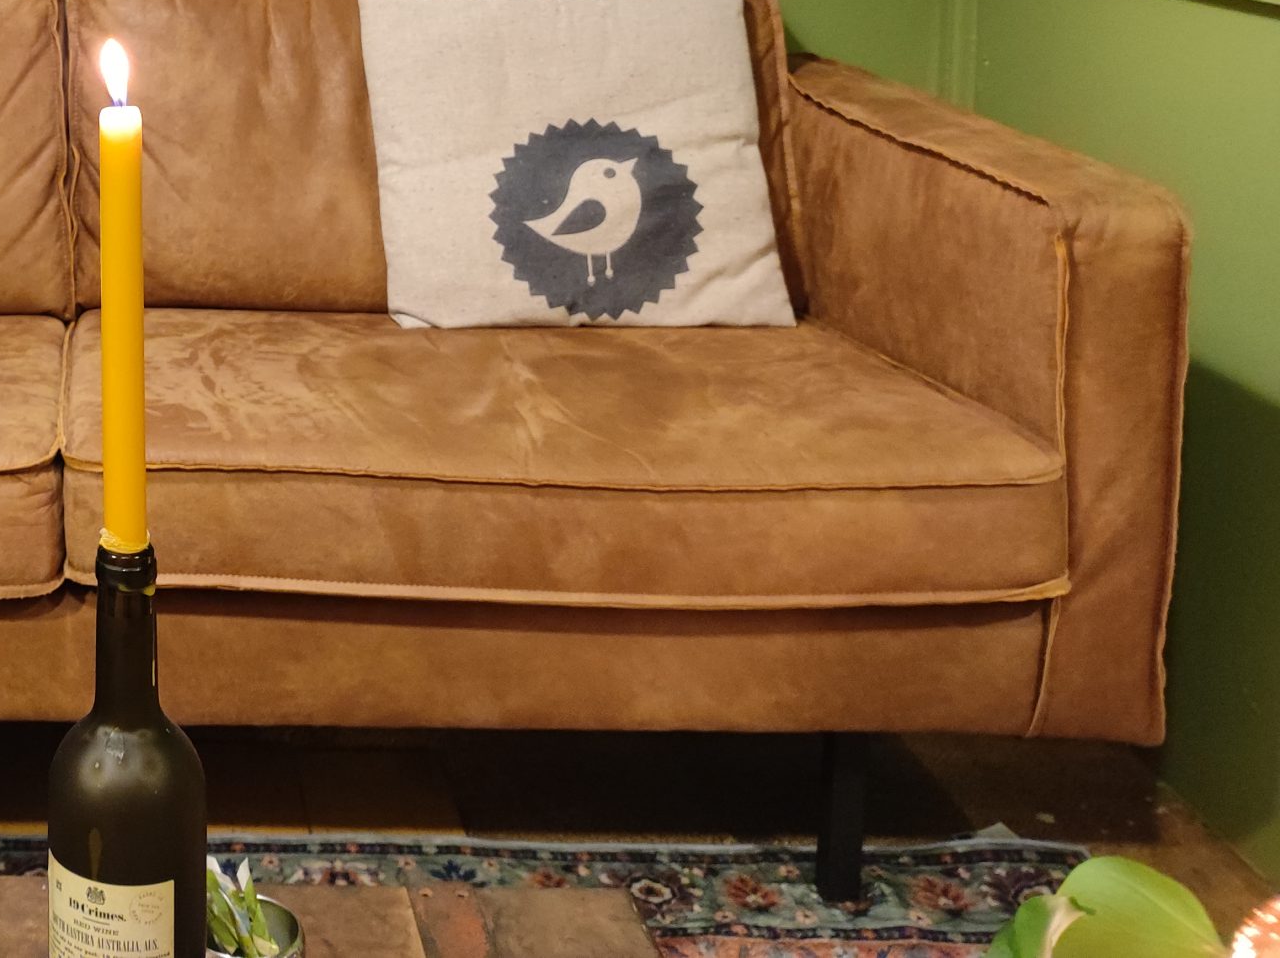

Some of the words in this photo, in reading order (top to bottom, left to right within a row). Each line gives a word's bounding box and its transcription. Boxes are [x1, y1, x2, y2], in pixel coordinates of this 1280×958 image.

[69, 897, 80, 910] 19
[81, 903, 127, 922] Crimes.
[66, 923, 95, 947] EASTERN
[73, 918, 91, 930] RED
[93, 925, 119, 936] WINE
